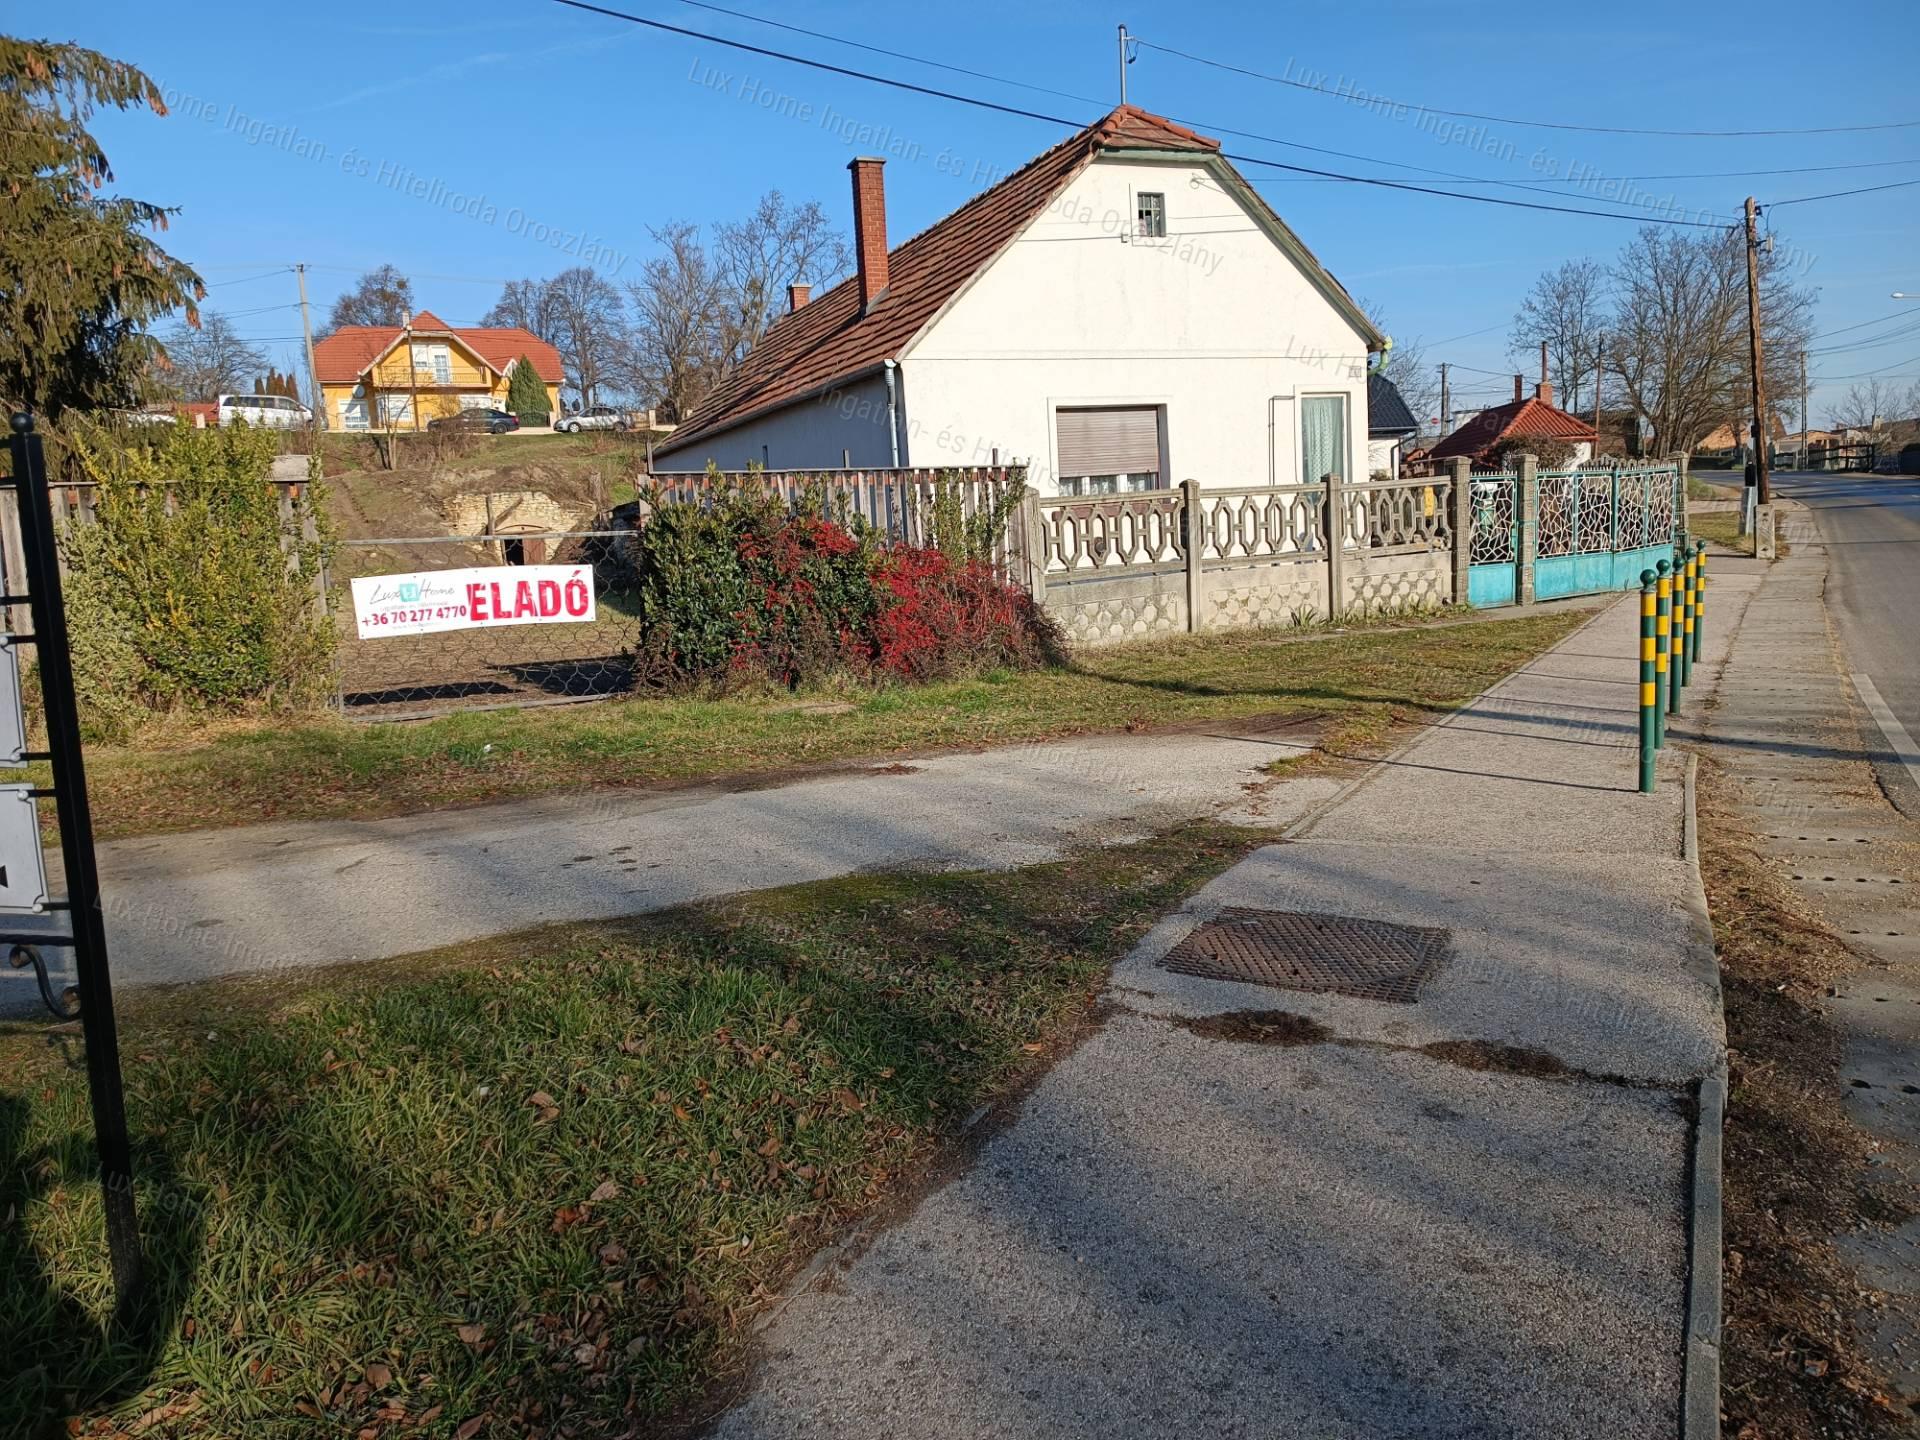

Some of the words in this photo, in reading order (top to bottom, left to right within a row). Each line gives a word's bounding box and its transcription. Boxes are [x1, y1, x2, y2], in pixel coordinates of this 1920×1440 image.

[370, 584, 401, 605] Lux
[419, 578, 455, 599] Home
[466, 569, 589, 621] ELADÓ
[361, 613, 389, 627] +36
[391, 610, 407, 624] 70
[409, 607, 433, 622] 277
[436, 604, 467, 619] 4770
